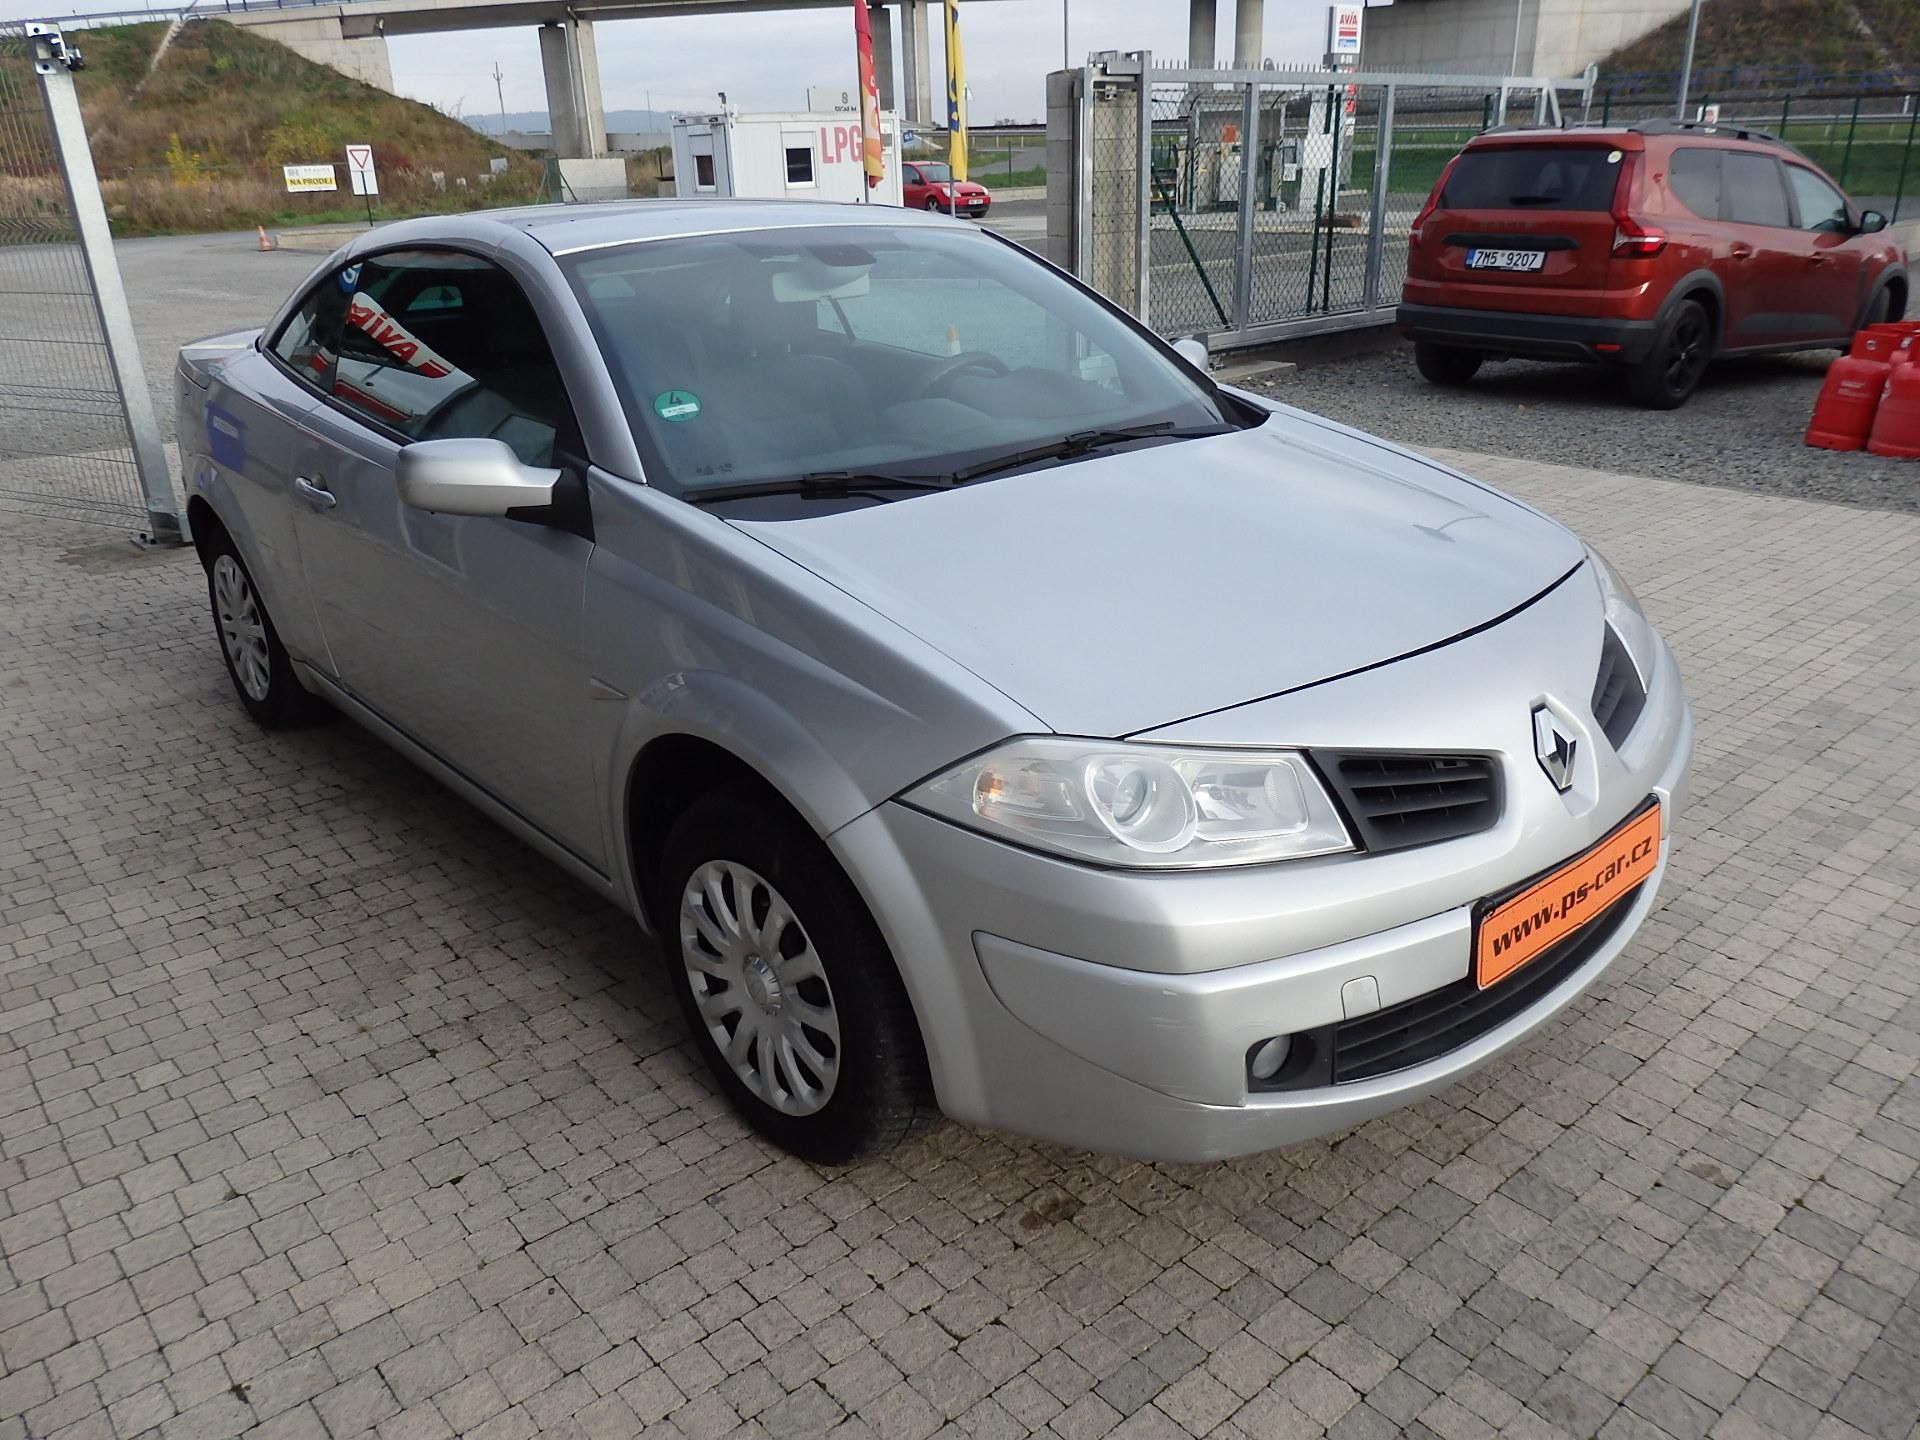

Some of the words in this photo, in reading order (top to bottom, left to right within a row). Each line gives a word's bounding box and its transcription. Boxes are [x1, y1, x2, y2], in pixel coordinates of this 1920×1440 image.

[821, 125, 864, 164] LPG
[1506, 252, 1538, 267] 9207
[669, 391, 683, 405] 4
[1492, 835, 1652, 957] www.ps-car.cz
